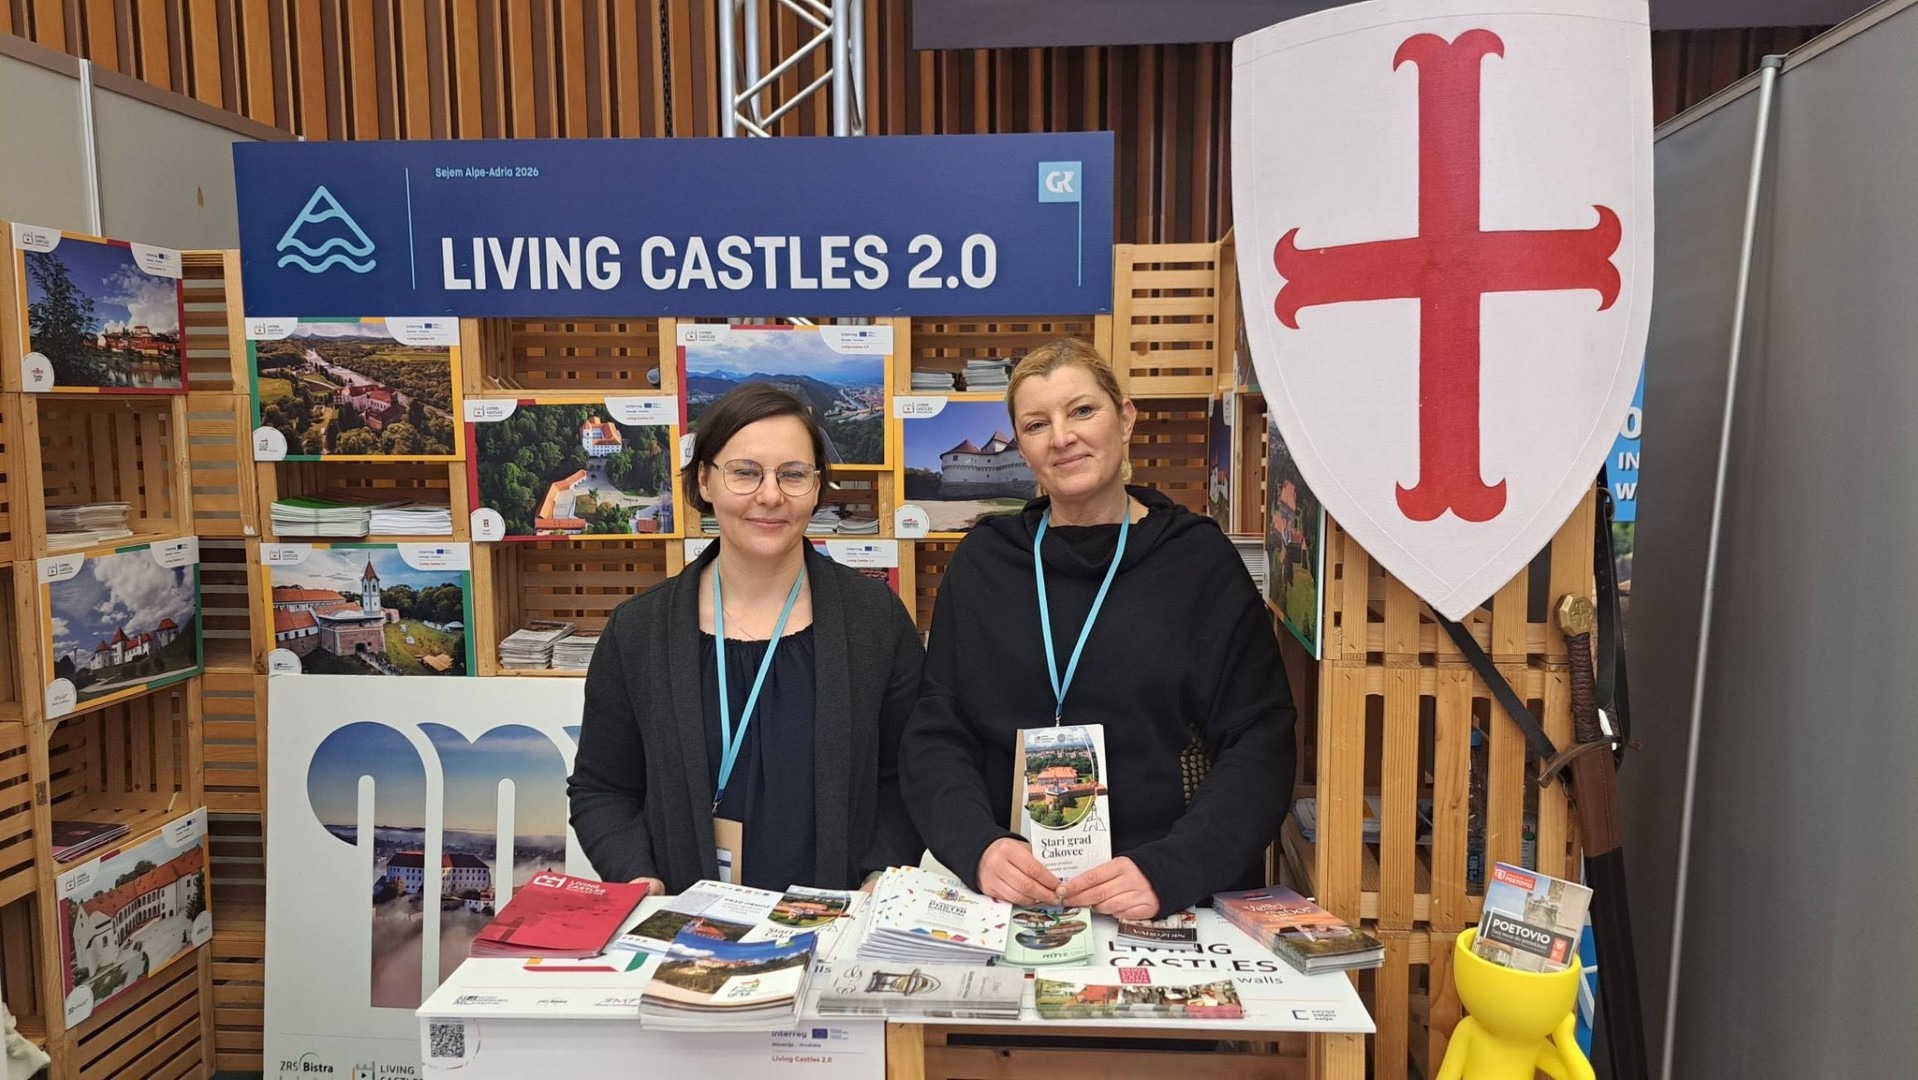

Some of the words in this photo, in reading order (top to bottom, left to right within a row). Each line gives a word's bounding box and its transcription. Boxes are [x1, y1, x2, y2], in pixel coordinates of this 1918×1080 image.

[435, 166, 463, 179] Sejem
[465, 167, 513, 179] Alpe-Adria
[515, 167, 539, 177] 2026
[1045, 171, 1074, 193] GK
[441, 236, 621, 291] LIVING
[640, 234, 889, 290] CASTLES
[908, 233, 997, 289] 2.0
[1041, 835, 1066, 849] Stari
[1067, 833, 1092, 847] grad
[1041, 846, 1084, 859] Čakovec
[567, 884, 606, 894] CASTLES
[570, 880, 600, 888] LIVING
[1492, 918, 1551, 945] POETOVIO
[1109, 957, 1278, 972] CASTLES
[1237, 974, 1283, 985] walls
[280, 1060, 298, 1071] ZRS
[303, 1061, 334, 1073] Bistra
[380, 1064, 415, 1075] LIVING
